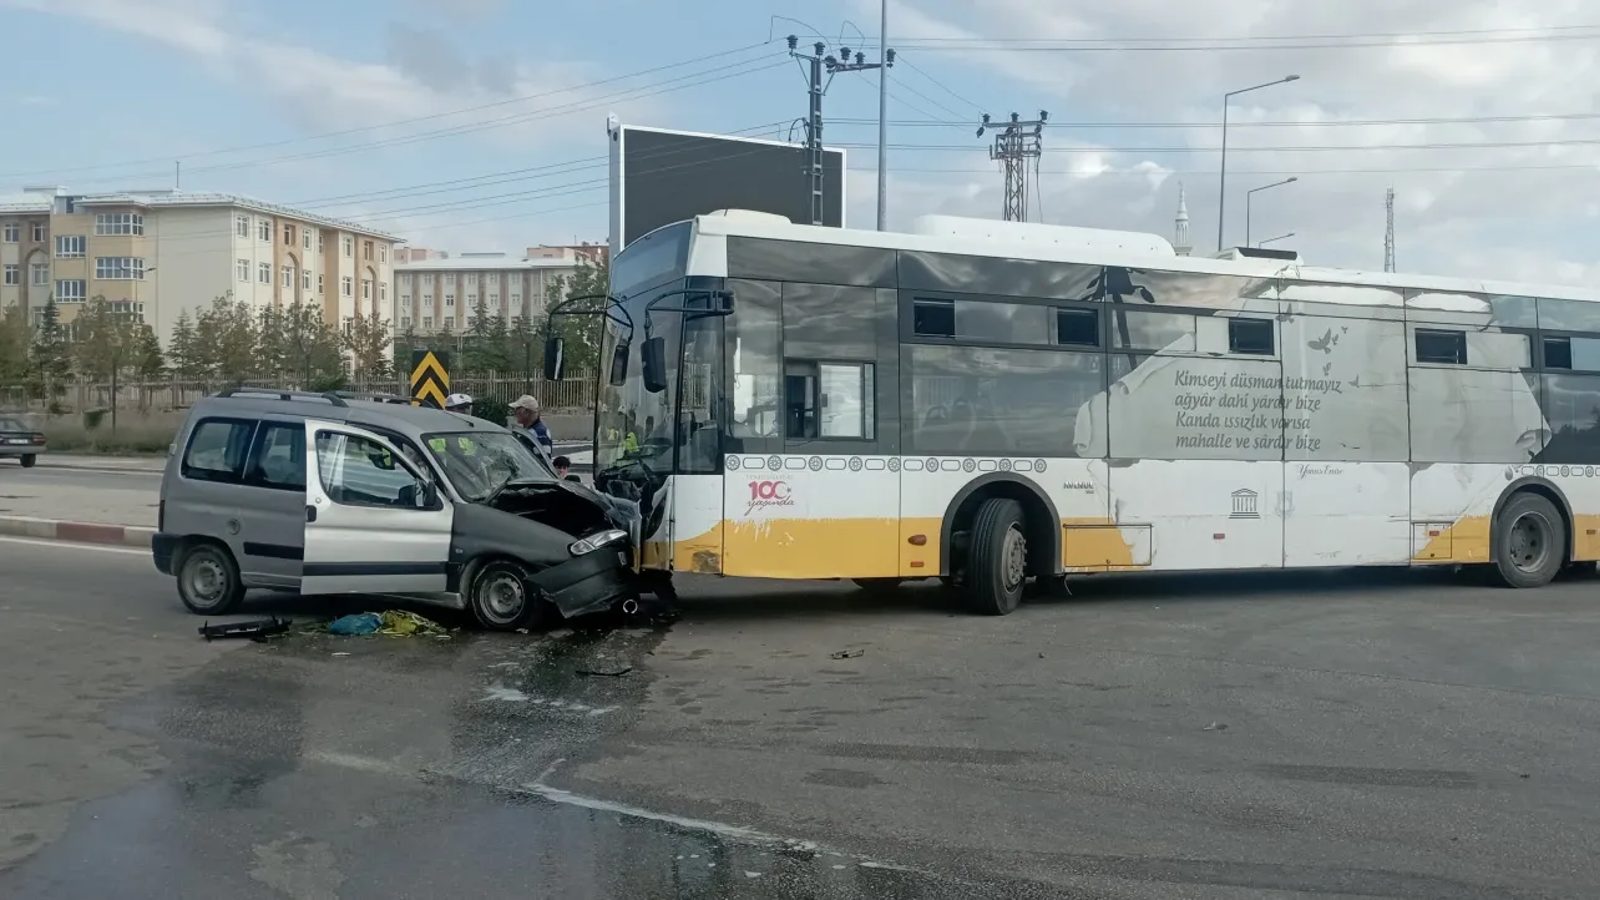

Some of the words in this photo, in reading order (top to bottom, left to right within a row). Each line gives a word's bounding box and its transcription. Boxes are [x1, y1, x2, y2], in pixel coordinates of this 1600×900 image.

[1174, 370, 1227, 391] Kimseyi
[1285, 376, 1343, 394] tutmayız
[1219, 393, 1249, 409] dahi
[1251, 394, 1293, 412] yârdr
[1295, 395, 1321, 412] bize
[1176, 411, 1220, 428] Kanda
[1176, 434, 1232, 449] mahalle
[1236, 436, 1250, 449] ve
[1295, 434, 1321, 452] bize
[748, 480, 791, 501] 100
